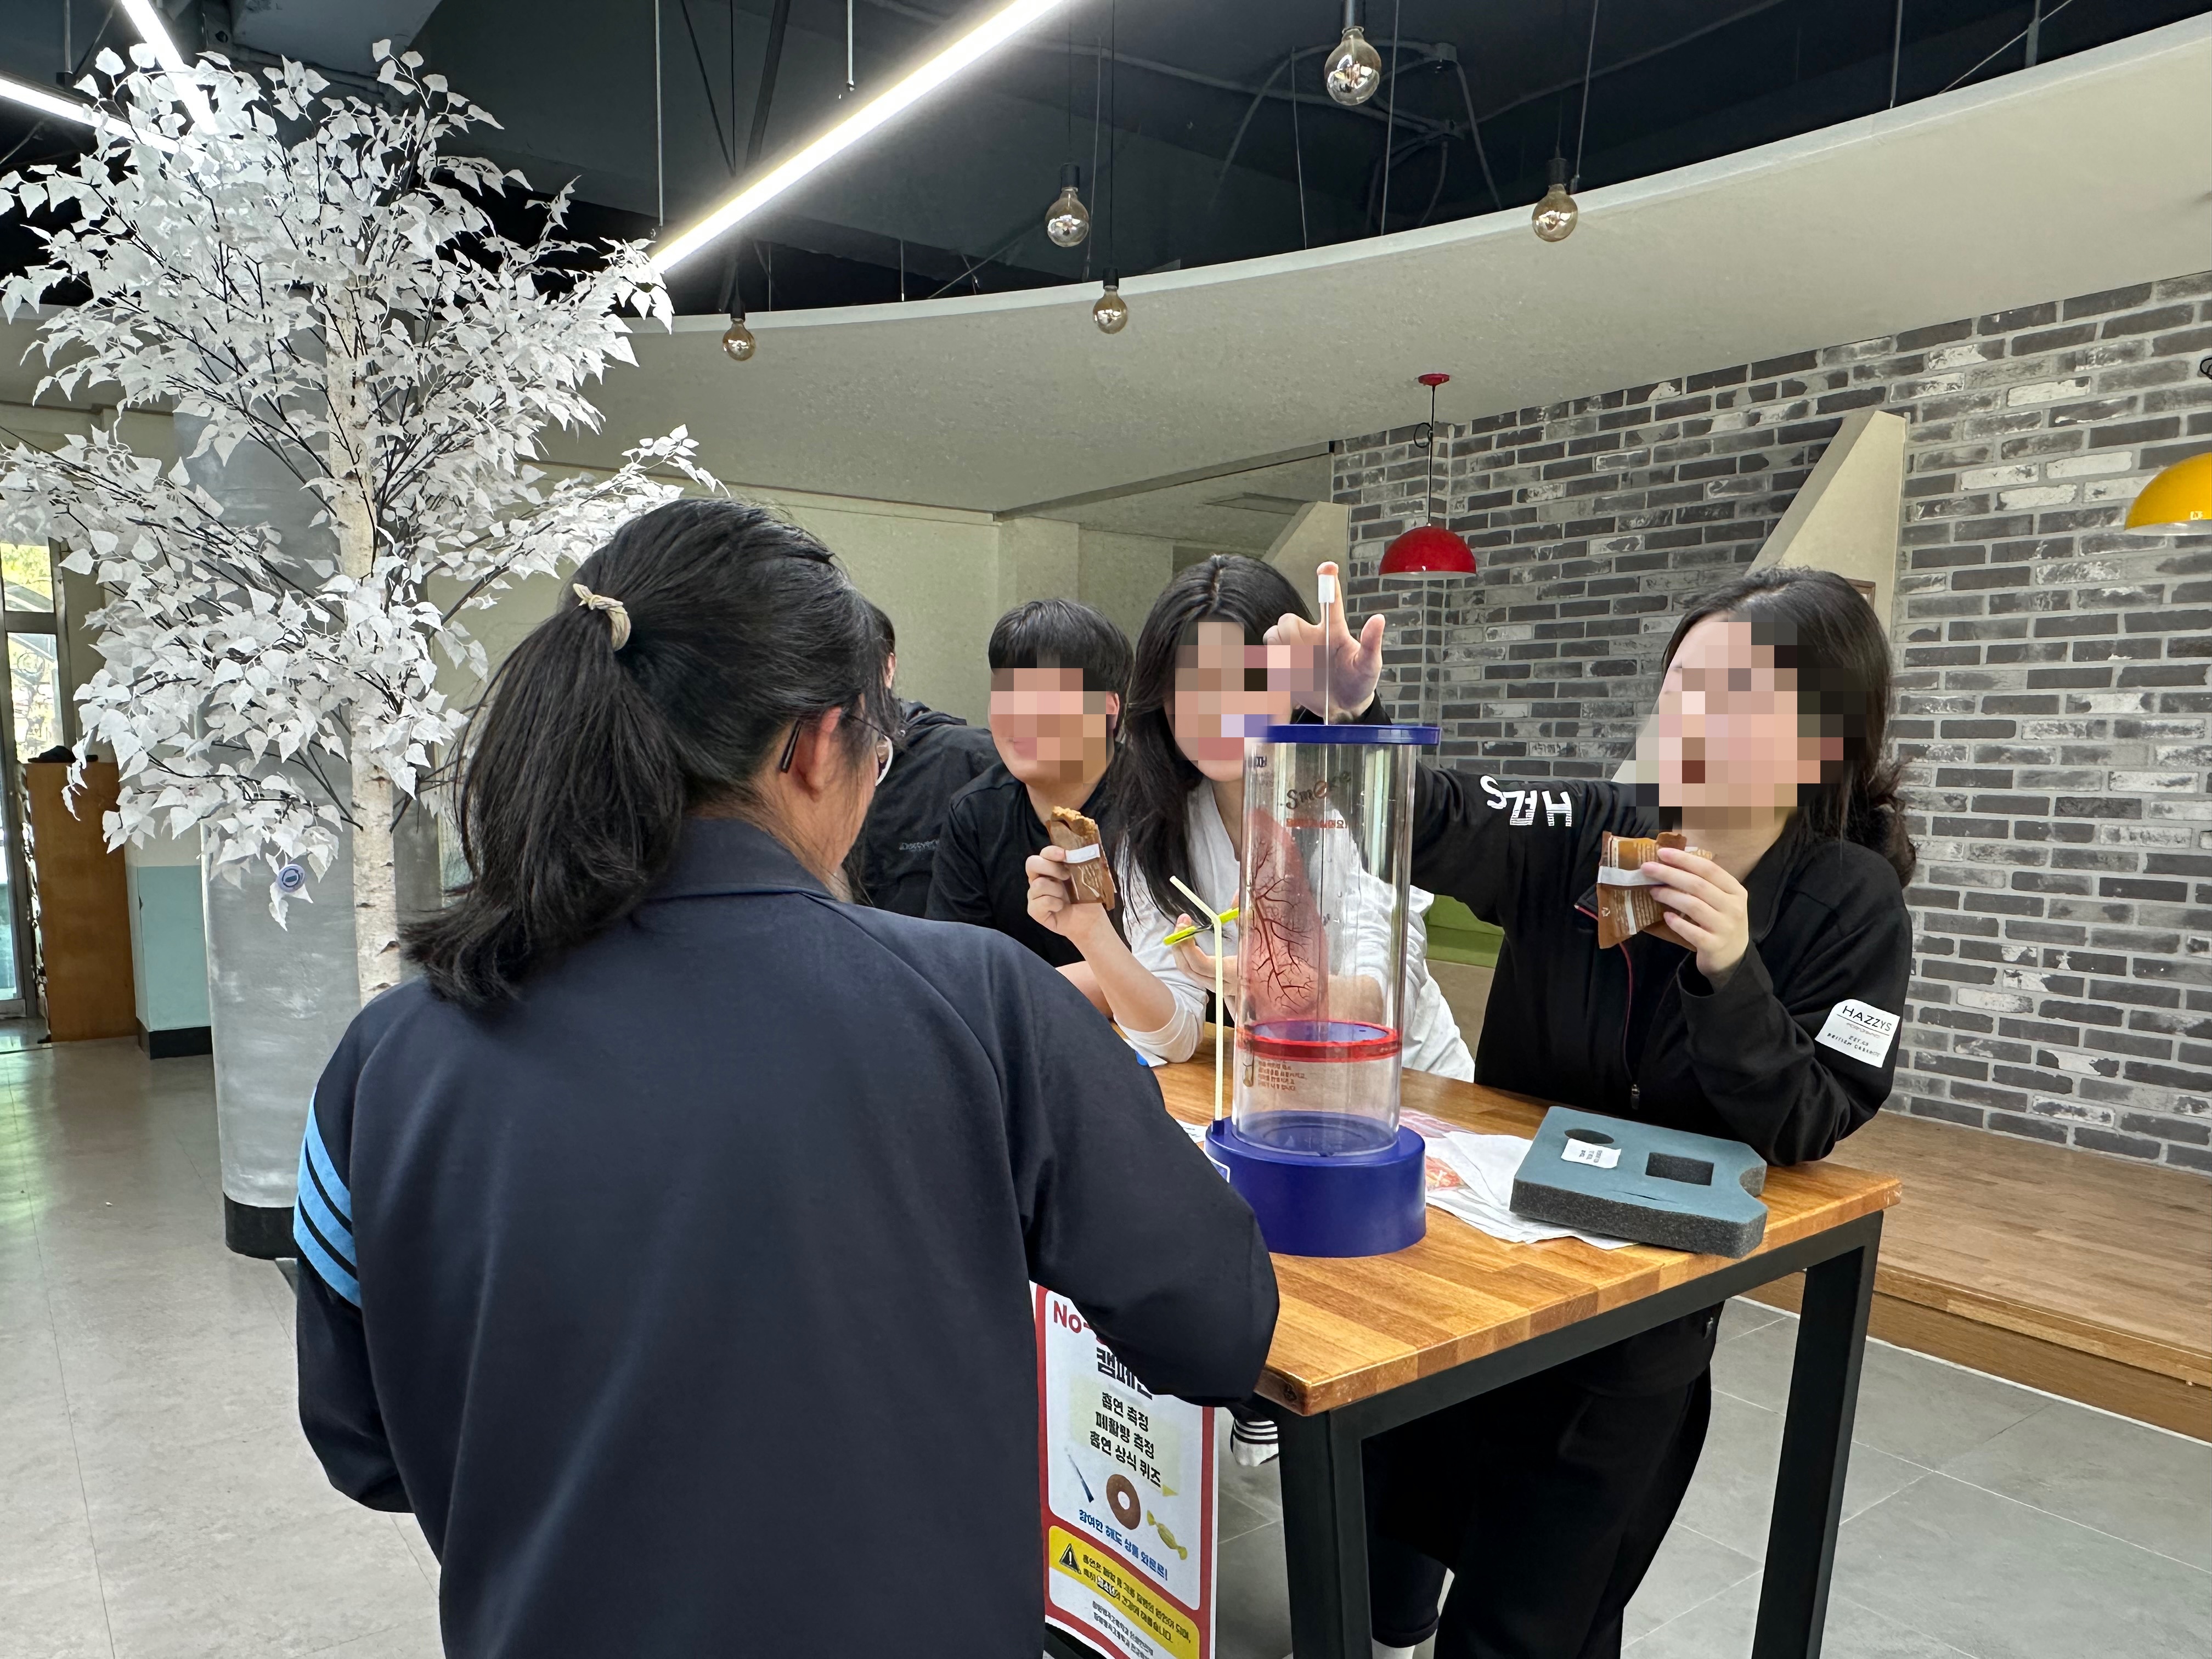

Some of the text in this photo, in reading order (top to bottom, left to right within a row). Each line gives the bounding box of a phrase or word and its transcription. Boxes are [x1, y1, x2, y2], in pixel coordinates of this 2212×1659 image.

[1842, 1006, 1892, 1031] HAZZYS
[1102, 1392, 1148, 1432] 흡연 측정
[1133, 1432, 1154, 1459] 측정
[1090, 1431, 1161, 1488] 흡연 상식 퀴즈
[1105, 1525, 1122, 1546] 해도
